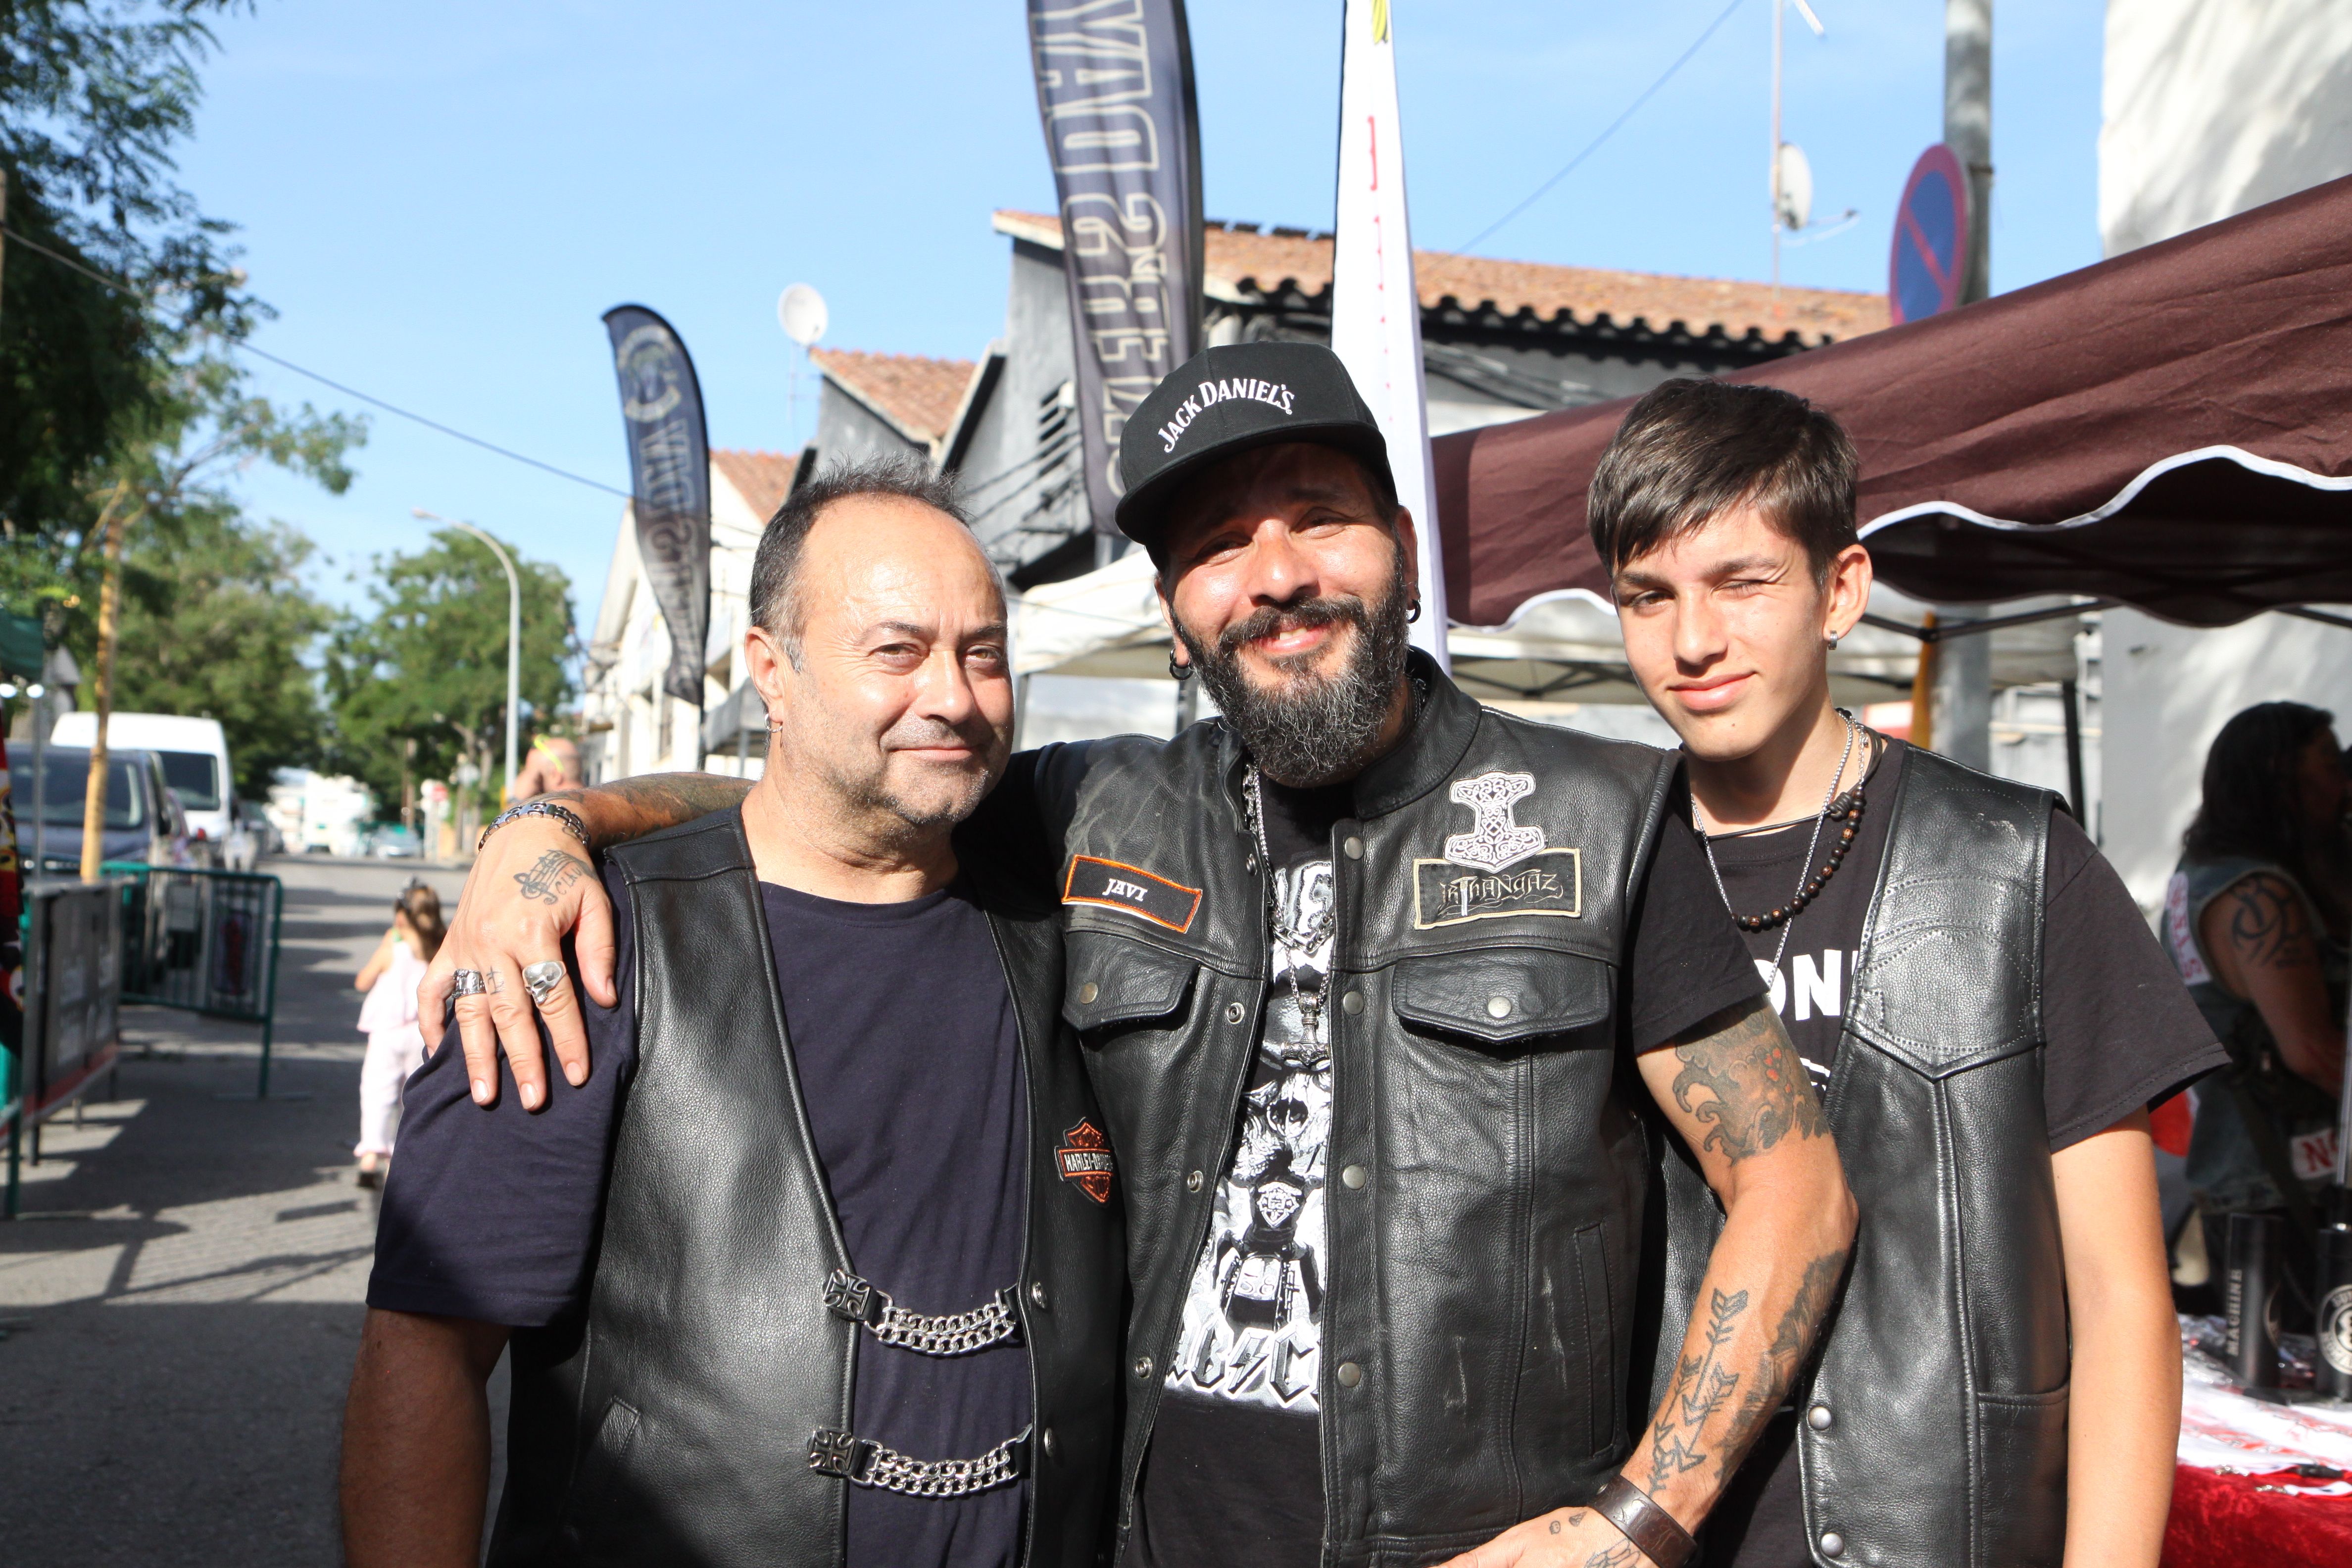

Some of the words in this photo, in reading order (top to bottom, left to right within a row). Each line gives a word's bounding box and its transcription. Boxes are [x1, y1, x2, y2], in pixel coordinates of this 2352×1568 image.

[1157, 394, 1203, 453] JACK
[1198, 378, 1295, 411] DANIEL'S
[1102, 878, 1148, 902] JAVI
